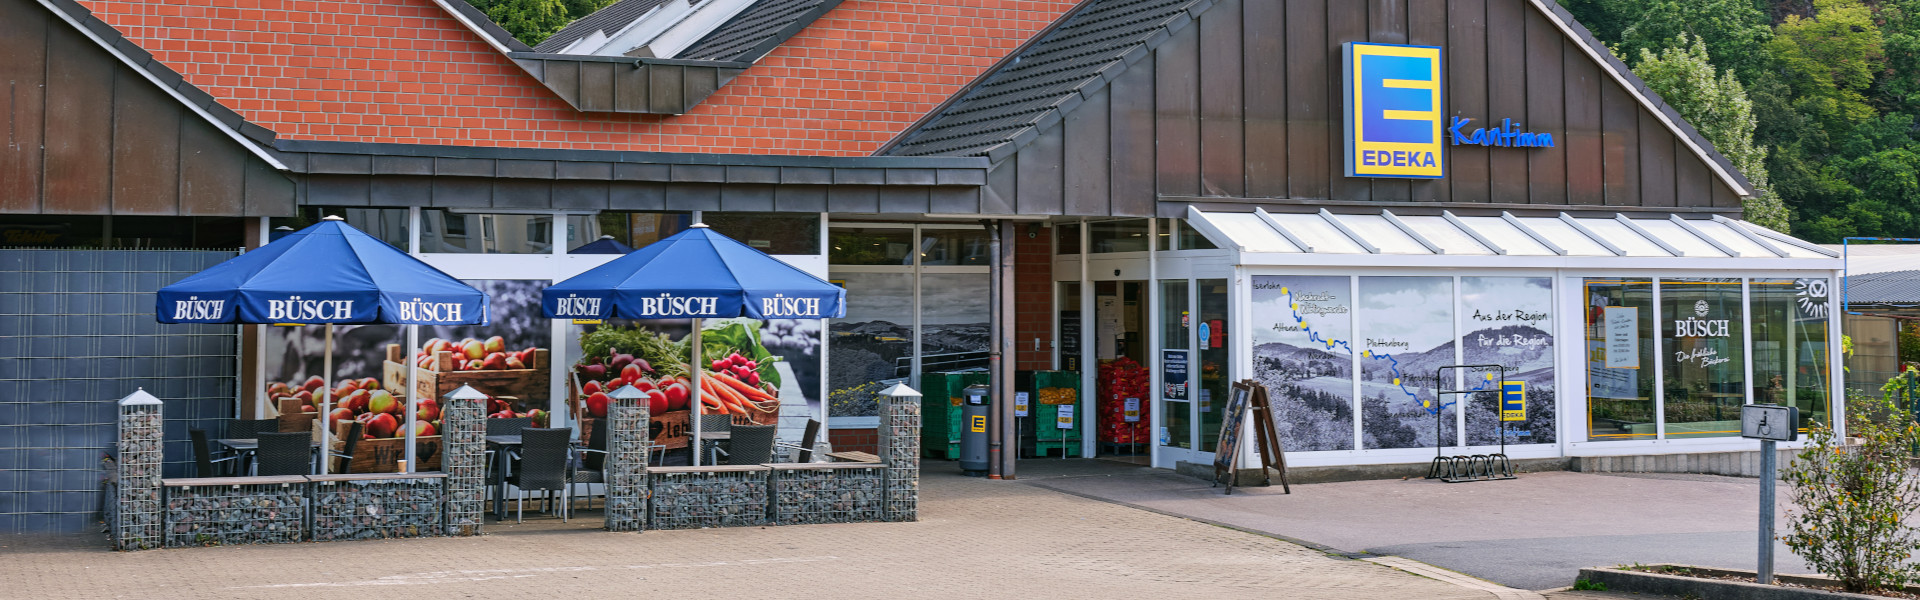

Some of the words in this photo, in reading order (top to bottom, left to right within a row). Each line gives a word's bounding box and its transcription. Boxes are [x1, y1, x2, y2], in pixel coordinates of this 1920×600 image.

[1449, 115, 1554, 148] Kantimm
[1362, 150, 1436, 168] EDEKA
[173, 296, 225, 320] BÜSCH
[267, 295, 355, 320] BÜSCH
[398, 297, 463, 323] BÜSCH
[555, 293, 602, 316] BÜSCH
[641, 293, 719, 317] BÜSCH
[762, 293, 821, 317] BÜSCH
[1473, 309, 1493, 322] Aus
[1495, 310, 1513, 321] der
[1515, 309, 1548, 326] Region
[1675, 316, 1730, 338] BÜSCH
[1367, 338, 1409, 351] Plettenberg
[1477, 333, 1494, 347] für
[1496, 334, 1512, 346] die
[374, 445, 403, 465] Wir
